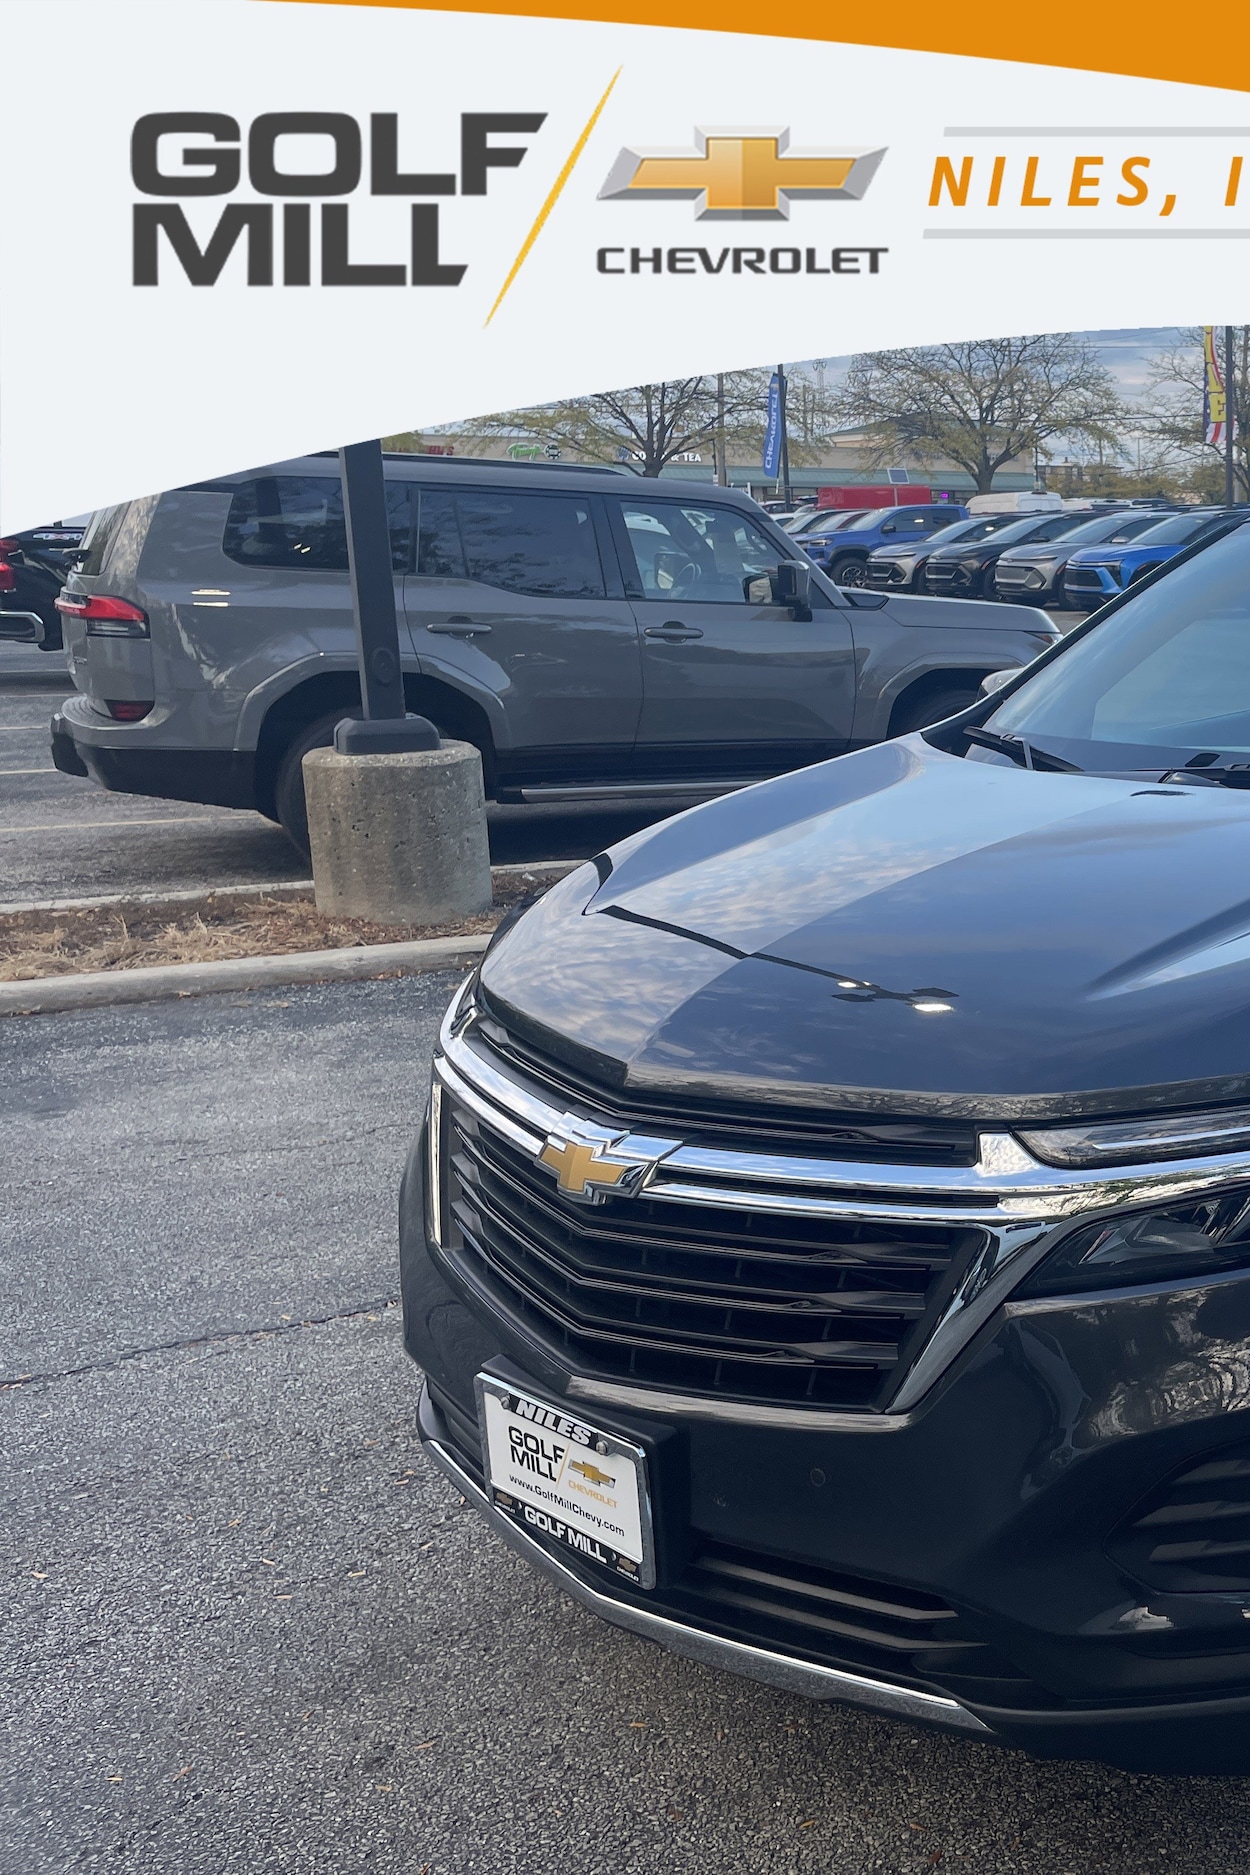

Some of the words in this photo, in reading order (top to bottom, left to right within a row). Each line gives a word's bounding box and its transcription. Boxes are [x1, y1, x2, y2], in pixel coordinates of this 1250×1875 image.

[683, 452, 702, 462] TEA
[515, 1399, 593, 1446] NILES
[508, 1425, 566, 1465] GOLF
[510, 1443, 558, 1483] MILL
[508, 1474, 626, 1538] www.GolfMillChevy.com
[567, 1479, 619, 1510] CHEVROLET
[524, 1506, 567, 1540] GOLF
[567, 1530, 608, 1564] MILL
